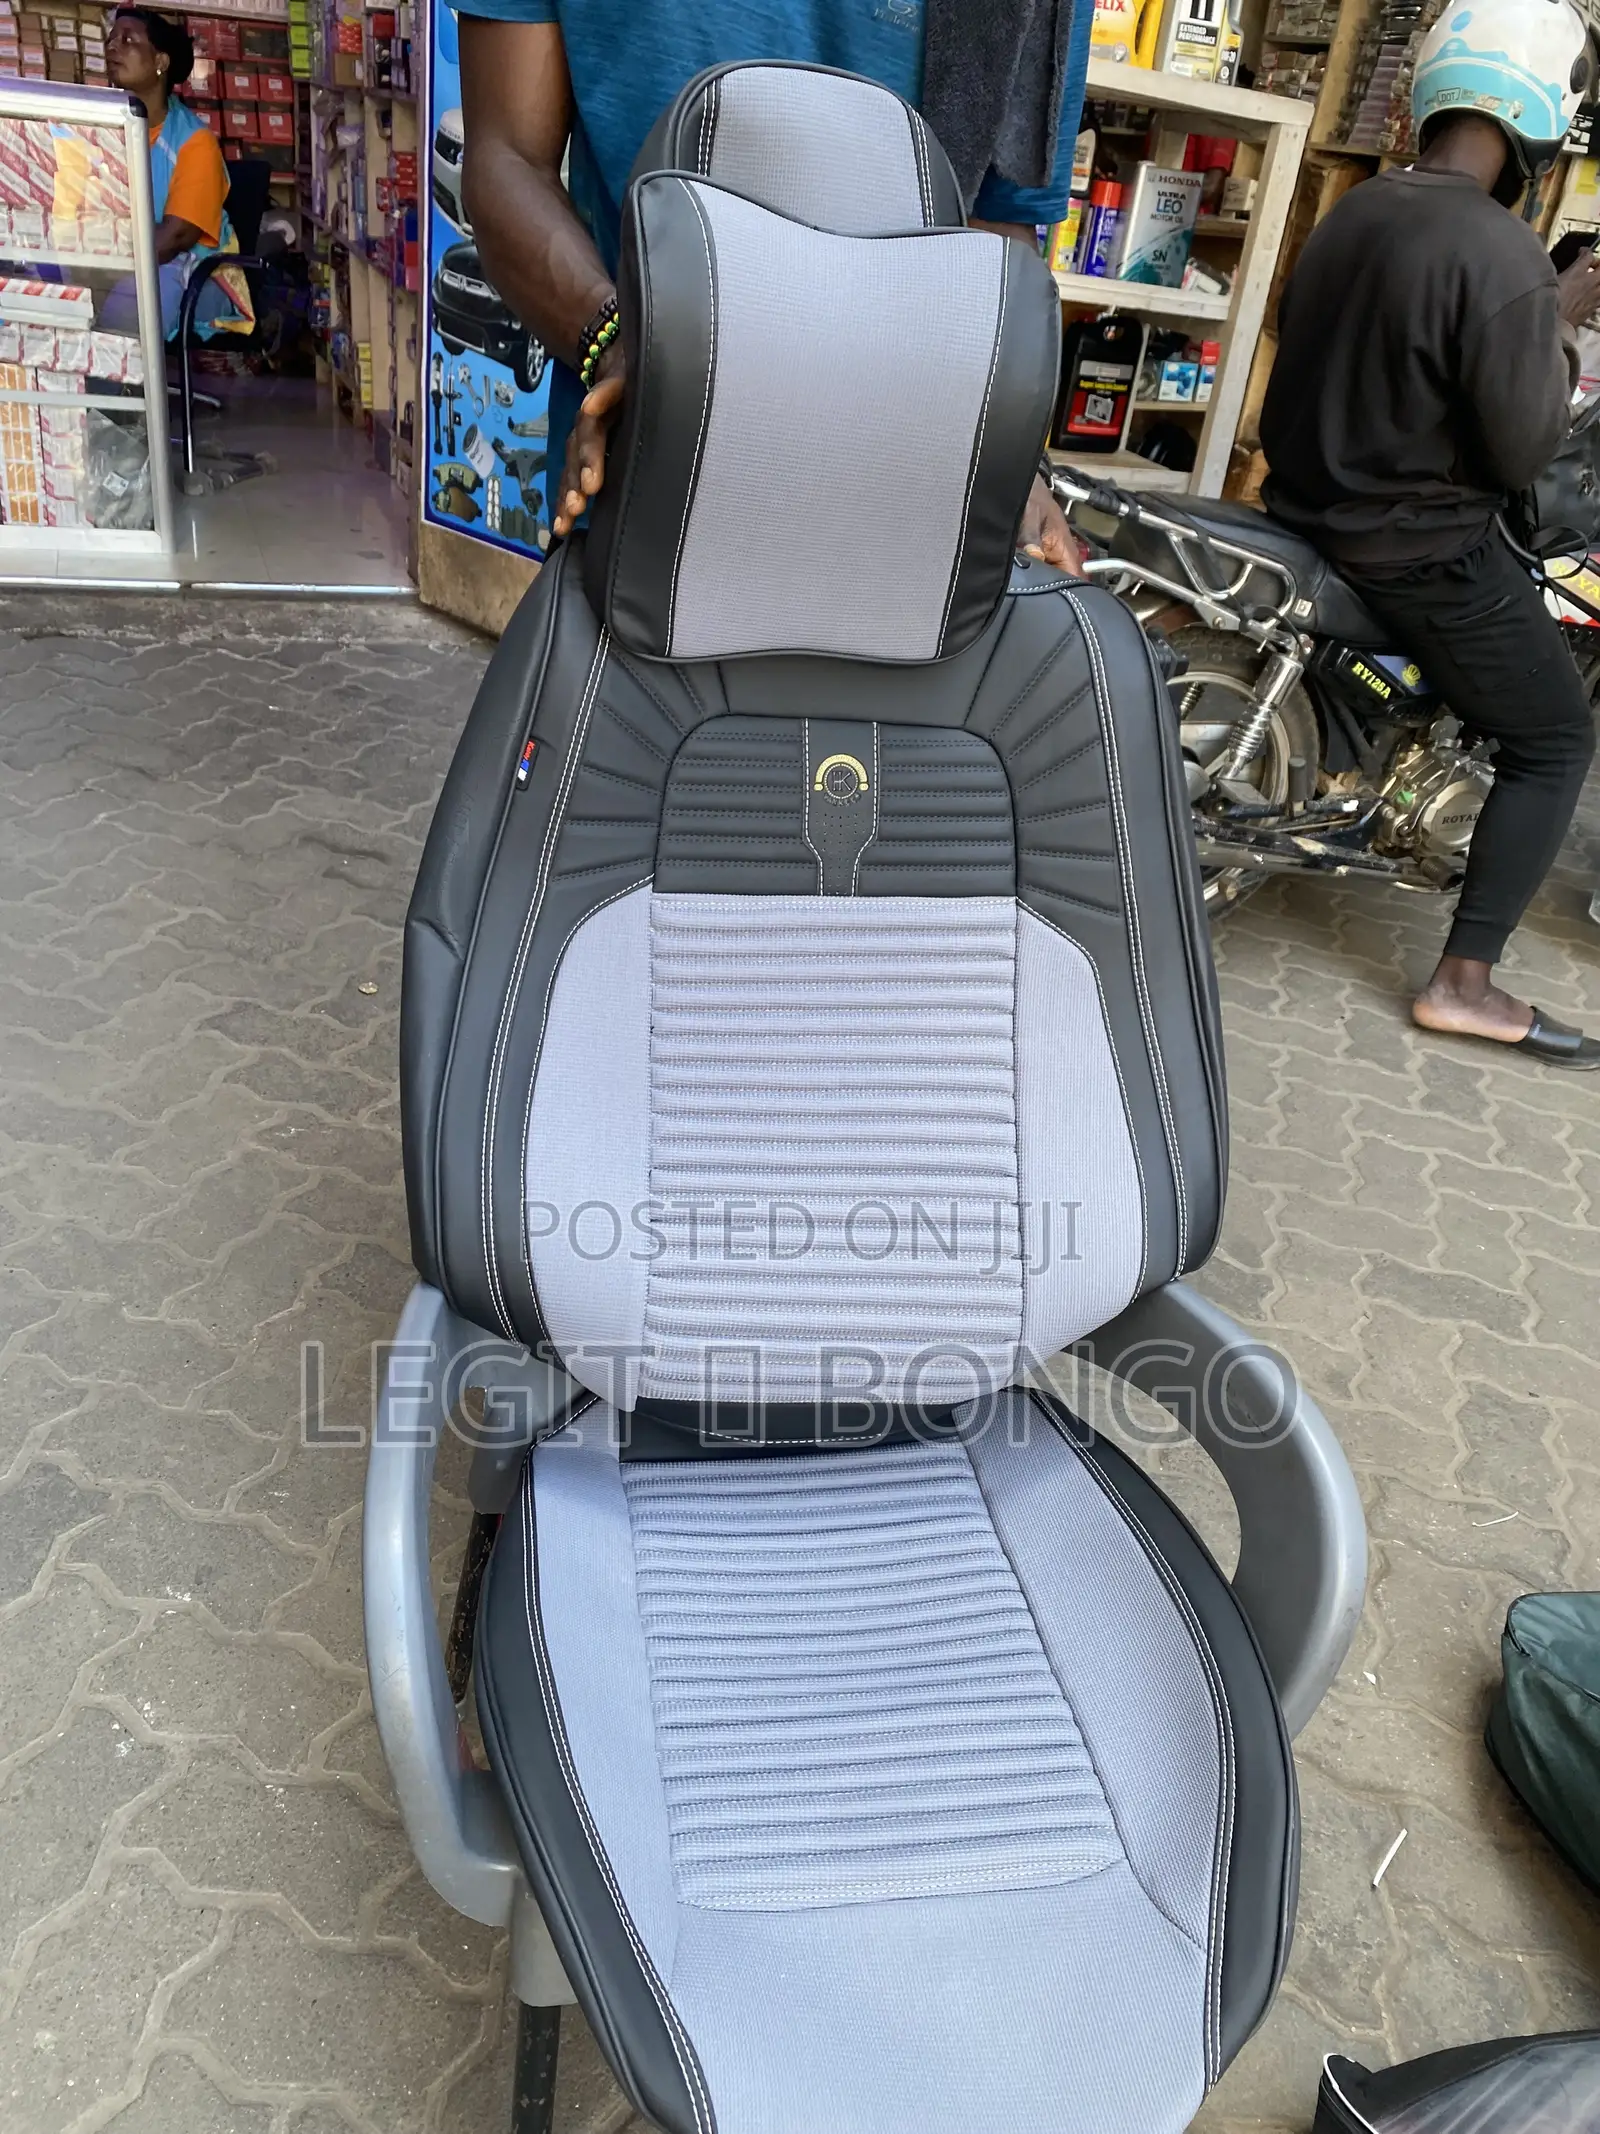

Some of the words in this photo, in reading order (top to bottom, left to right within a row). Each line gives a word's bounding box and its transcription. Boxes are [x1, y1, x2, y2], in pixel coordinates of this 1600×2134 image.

[1159, 175, 1202, 188] HONDA
[1157, 190, 1187, 200] ULTRA
[1156, 198, 1183, 214] LEO
[1150, 213, 1174, 222] MOTOR
[1152, 249, 1168, 262] SN
[1351, 661, 1392, 700] RY125A
